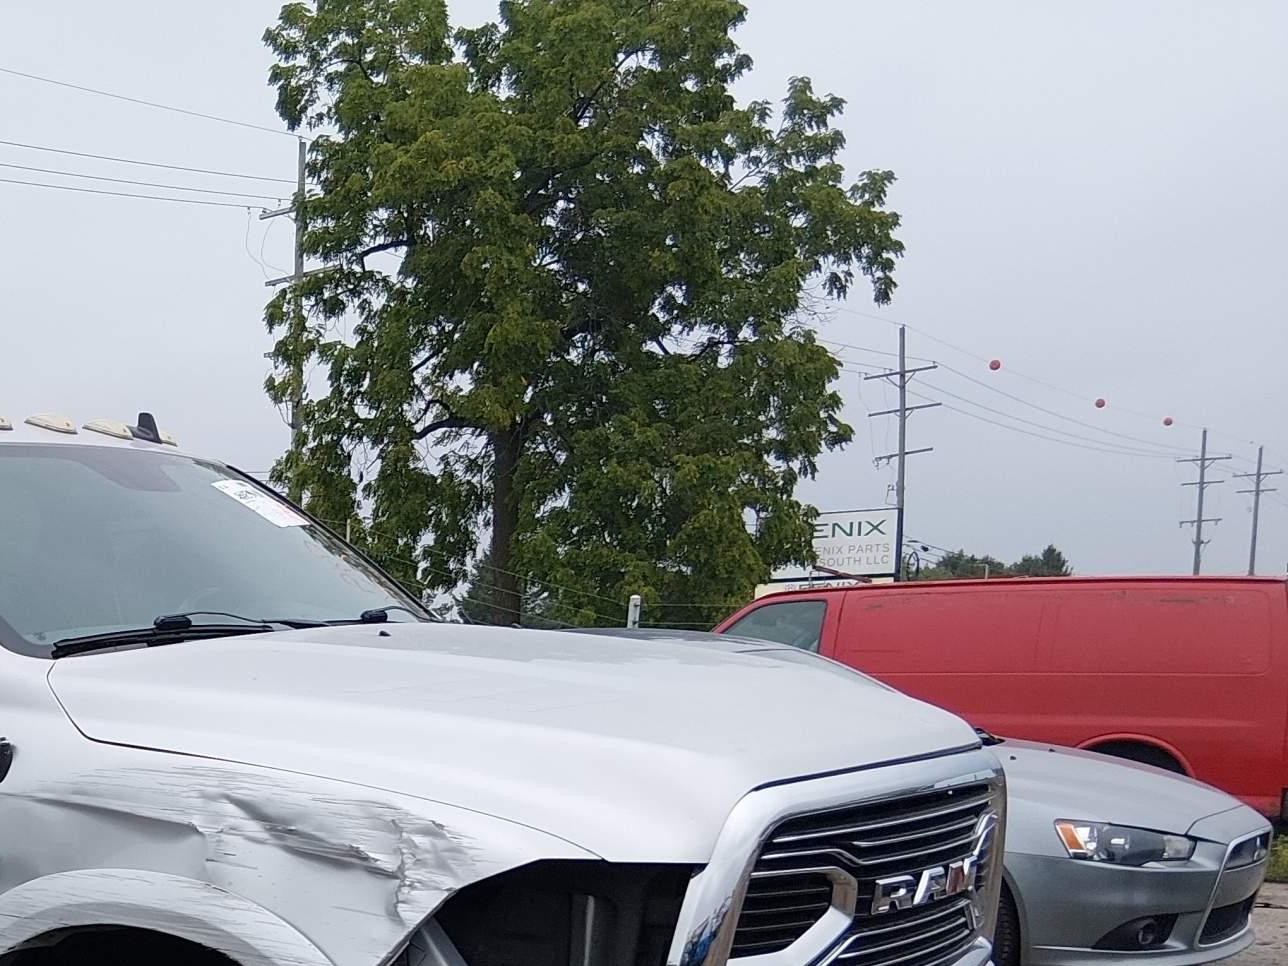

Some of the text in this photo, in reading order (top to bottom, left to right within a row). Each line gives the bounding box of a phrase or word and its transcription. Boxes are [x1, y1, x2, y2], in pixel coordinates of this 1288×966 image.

[813, 519, 886, 539] ENIX
[815, 543, 890, 557] ENIX PARTS
[819, 554, 889, 567] SOUTH LLC
[871, 855, 977, 915] RAM
